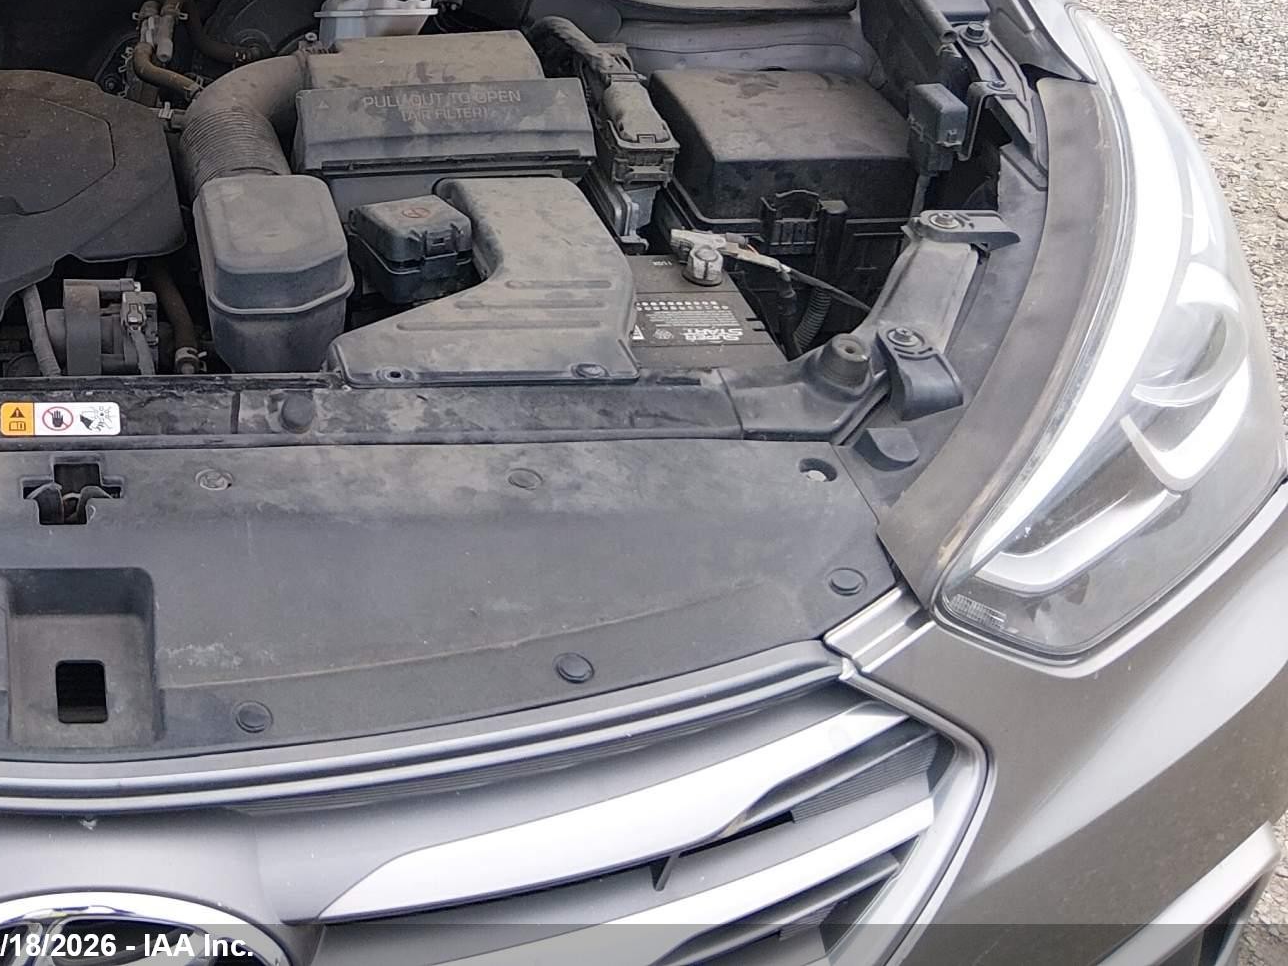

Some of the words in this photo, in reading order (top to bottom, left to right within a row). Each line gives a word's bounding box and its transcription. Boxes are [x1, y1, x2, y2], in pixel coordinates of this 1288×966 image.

[362, 94, 406, 109] PULL
[409, 92, 444, 107] OUT
[448, 91, 471, 105] TO
[472, 89, 522, 104] OPEN
